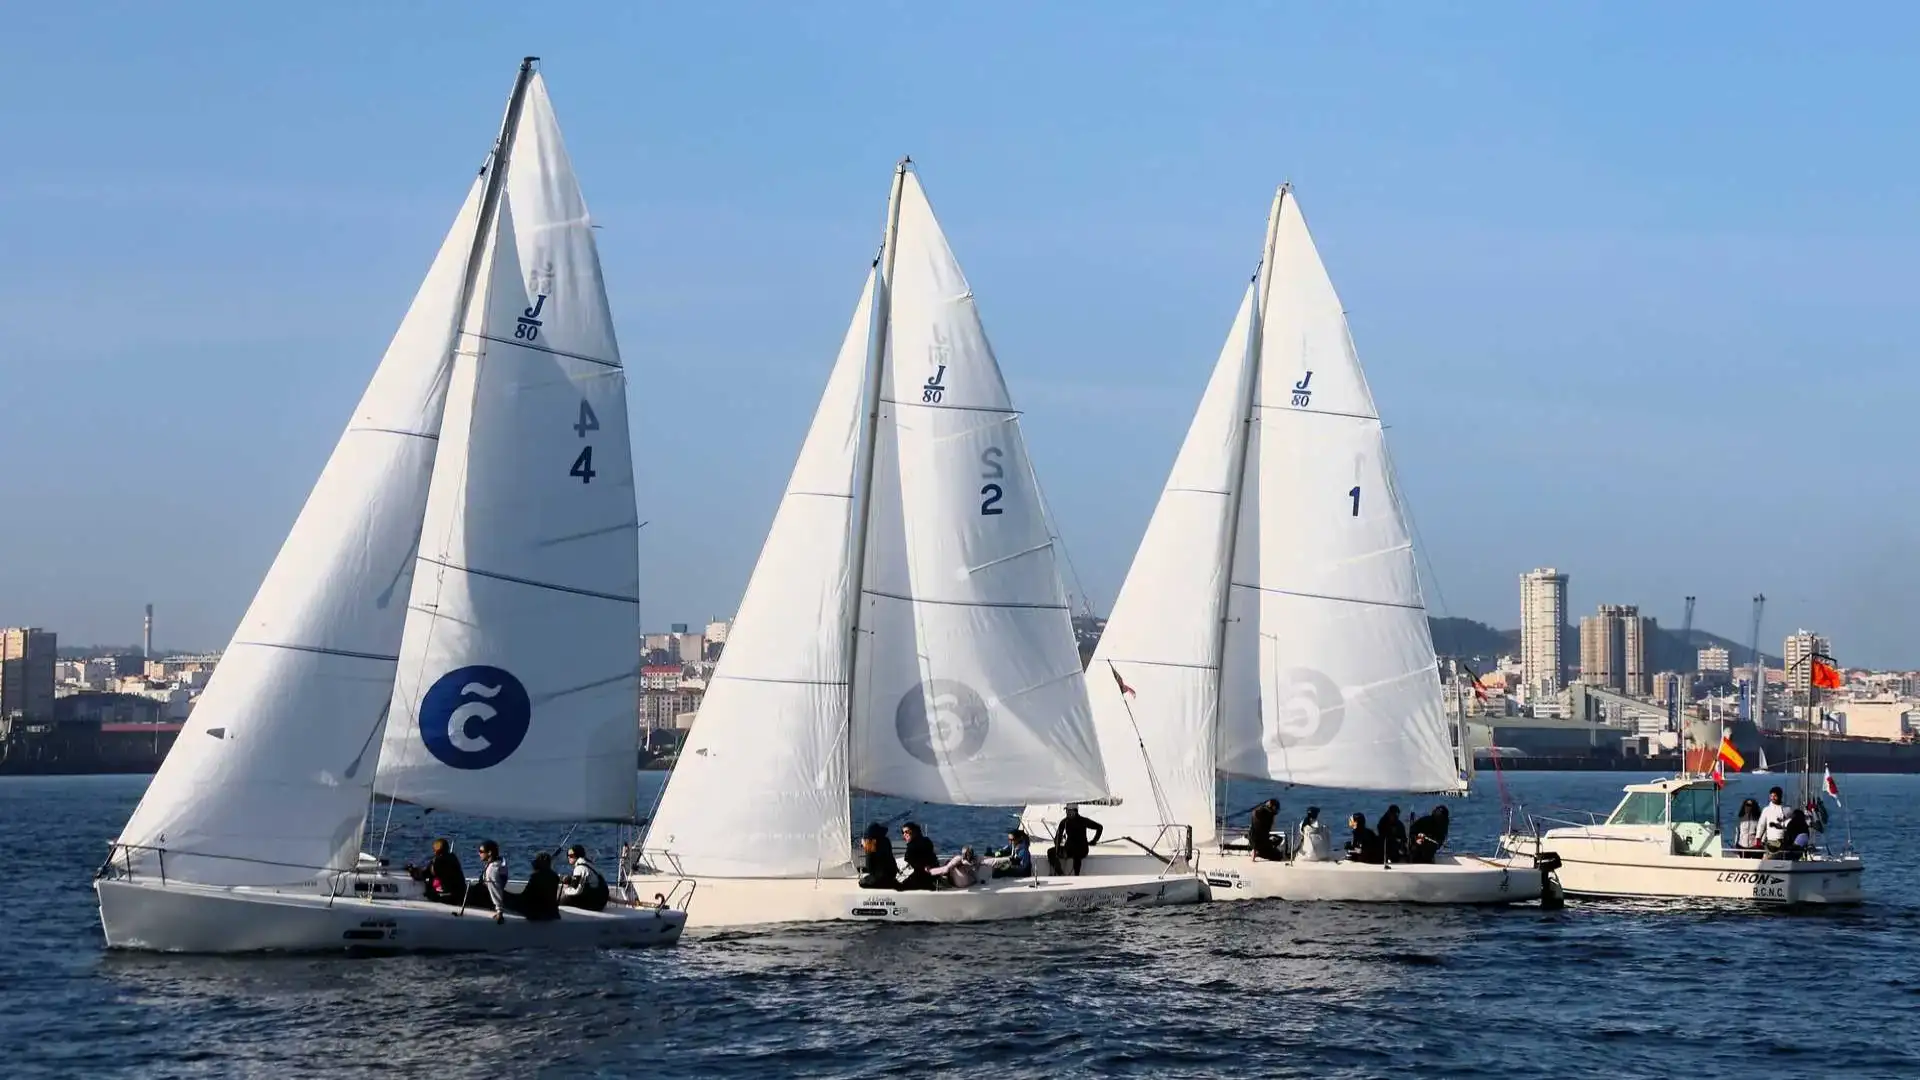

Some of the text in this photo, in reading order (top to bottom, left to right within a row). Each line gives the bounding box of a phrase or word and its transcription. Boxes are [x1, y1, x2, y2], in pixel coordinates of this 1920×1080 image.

[524, 294, 547, 318] J
[514, 323, 538, 341] 80
[927, 365, 946, 386] J
[1295, 371, 1313, 390] J
[922, 390, 943, 403] 80
[1291, 394, 1310, 408] 80
[569, 445, 596, 484] 4
[980, 483, 1003, 515] 2
[1348, 486, 1361, 517] 1
[1716, 872, 1770, 885] LEIRON
[1752, 887, 1785, 898] R.C.N.C.
